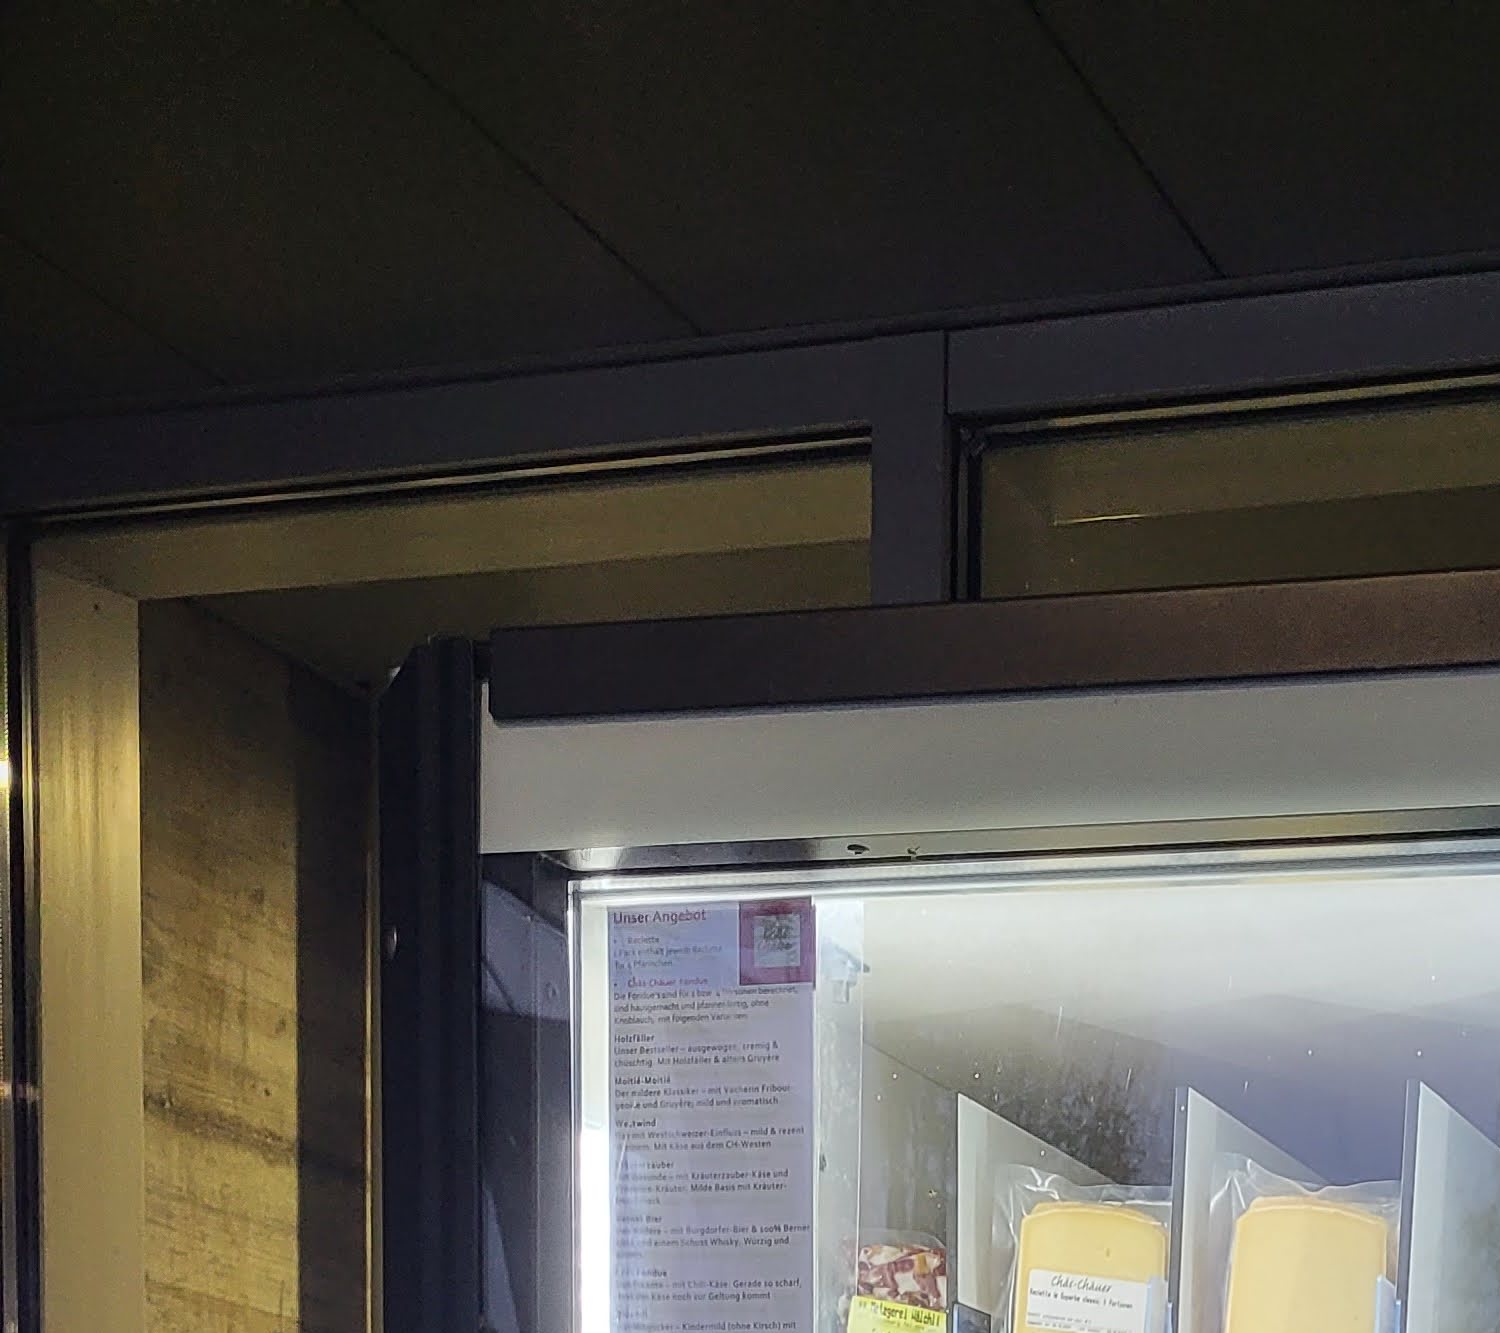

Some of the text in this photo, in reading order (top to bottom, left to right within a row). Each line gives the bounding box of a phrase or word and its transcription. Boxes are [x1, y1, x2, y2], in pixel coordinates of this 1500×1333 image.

[613, 909, 706, 925] Unser Angebot
[614, 1033, 655, 1043] Holzfäller
[733, 1280, 761, 1288] Gerade
